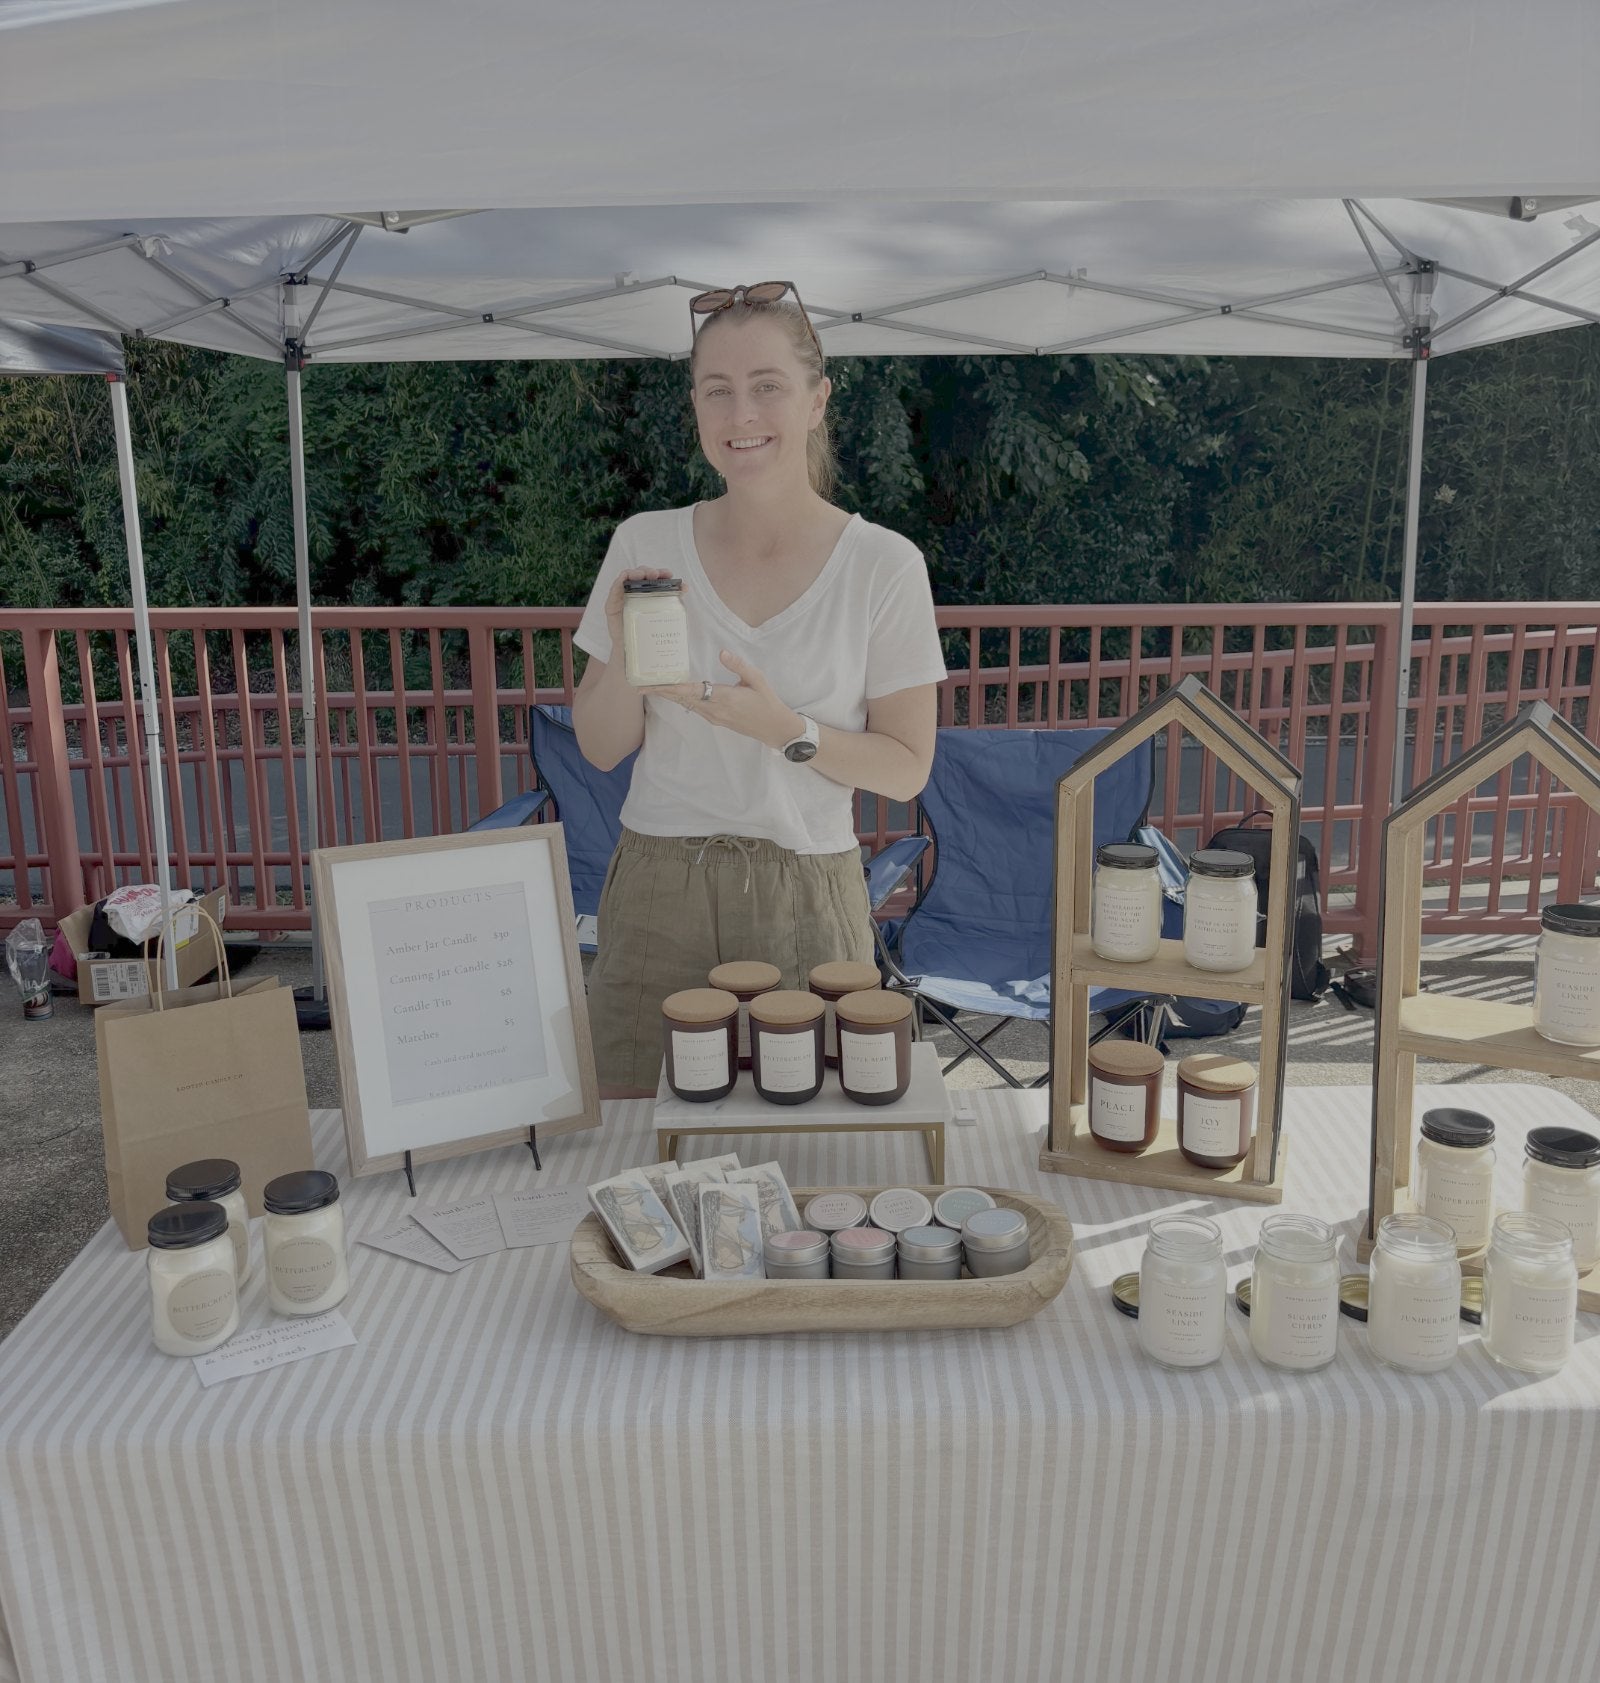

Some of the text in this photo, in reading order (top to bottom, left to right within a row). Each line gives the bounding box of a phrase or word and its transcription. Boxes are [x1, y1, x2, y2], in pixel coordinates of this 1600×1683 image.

[404, 891, 493, 912] PRODUCTS
[386, 931, 510, 956] Amber Jar Candle $30
[389, 958, 513, 985] Canning Jar Candle $28
[393, 1000, 431, 1016] Candle
[433, 997, 452, 1009] Tin
[397, 1017, 516, 1045] Matches $5
[458, 1050, 475, 1062] card
[1100, 1098, 1136, 1112] PEACE
[1200, 1115, 1221, 1127] JOY
[274, 1259, 333, 1275] BUTTERCREAM
[172, 1288, 233, 1314] BUTTERCREAM
[1165, 1308, 1204, 1318] SEASIDE
[1287, 1312, 1328, 1321] SUGARED
[1400, 1314, 1437, 1325] JUNIPER
[1515, 1313, 1553, 1325] COFFEE
[1171, 1318, 1200, 1328] LINEN
[1291, 1322, 1323, 1330] CITRUS
[205, 1319, 338, 1366] & Seasonal Seconds!
[253, 1345, 308, 1367] $15 each
